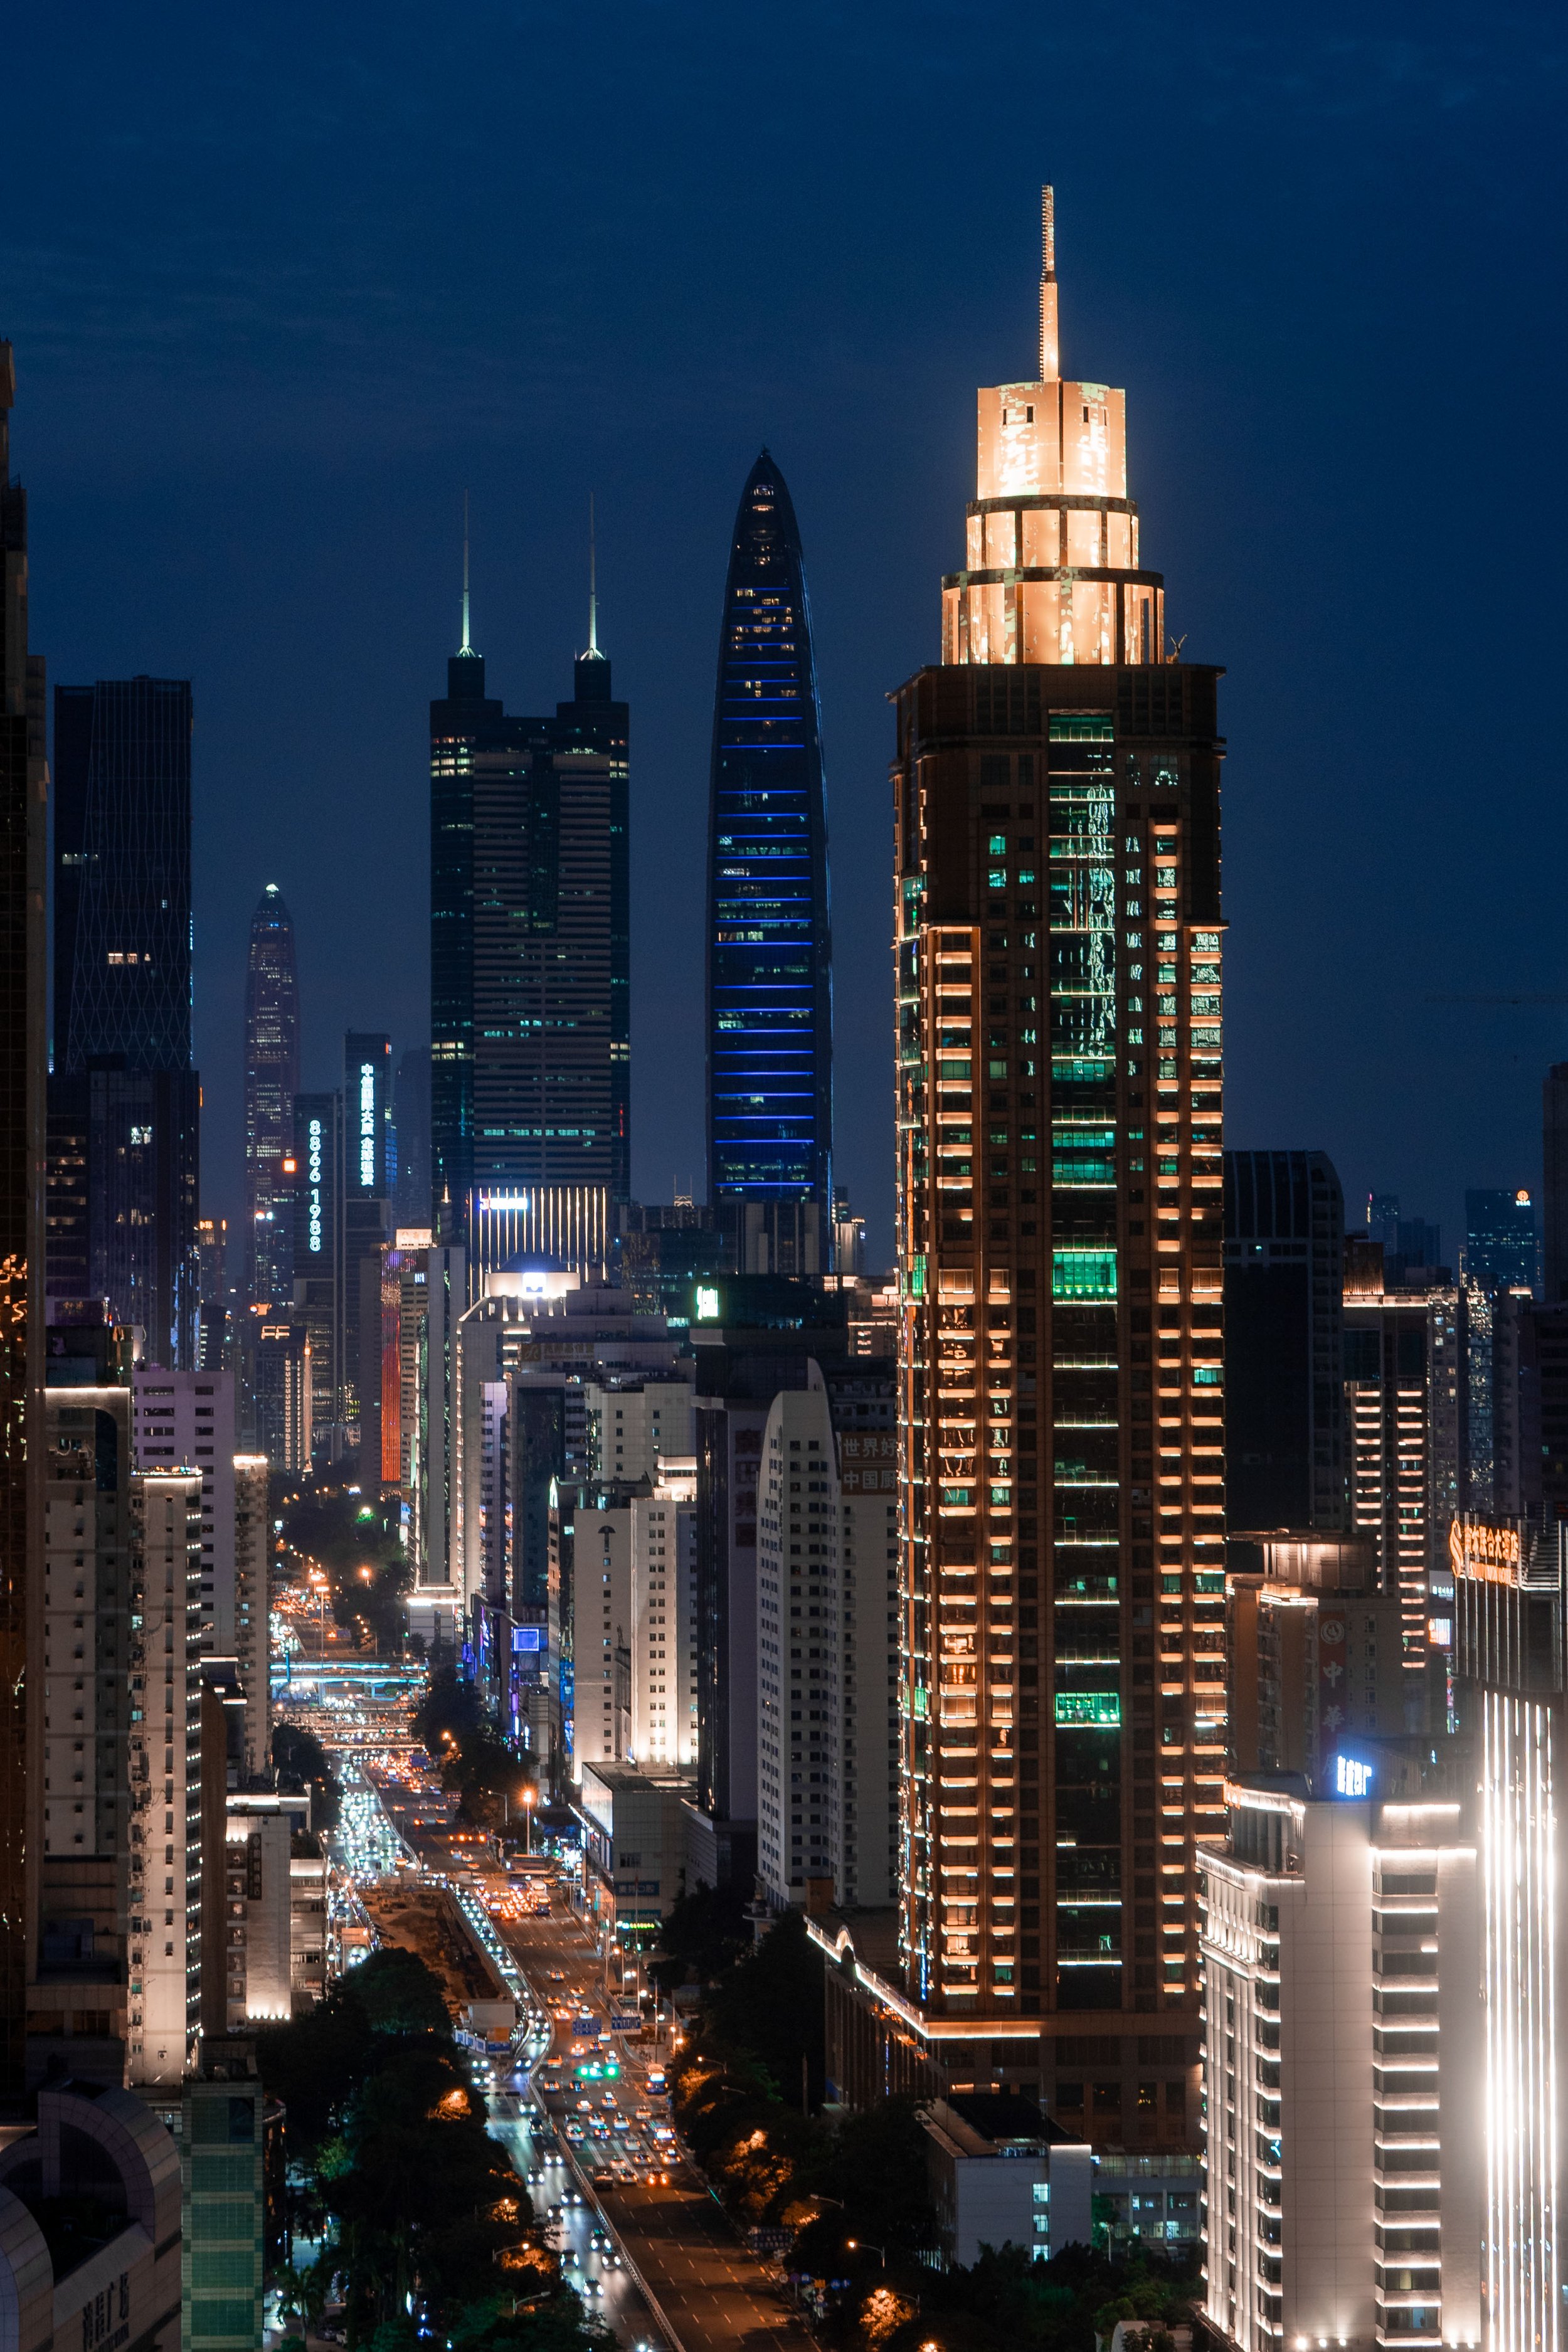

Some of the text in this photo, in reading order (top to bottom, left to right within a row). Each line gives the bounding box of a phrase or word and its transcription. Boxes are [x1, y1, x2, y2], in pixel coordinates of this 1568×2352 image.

[309, 1120, 321, 1251] 8866 1988
[843, 1438, 896, 1458] 世界好
